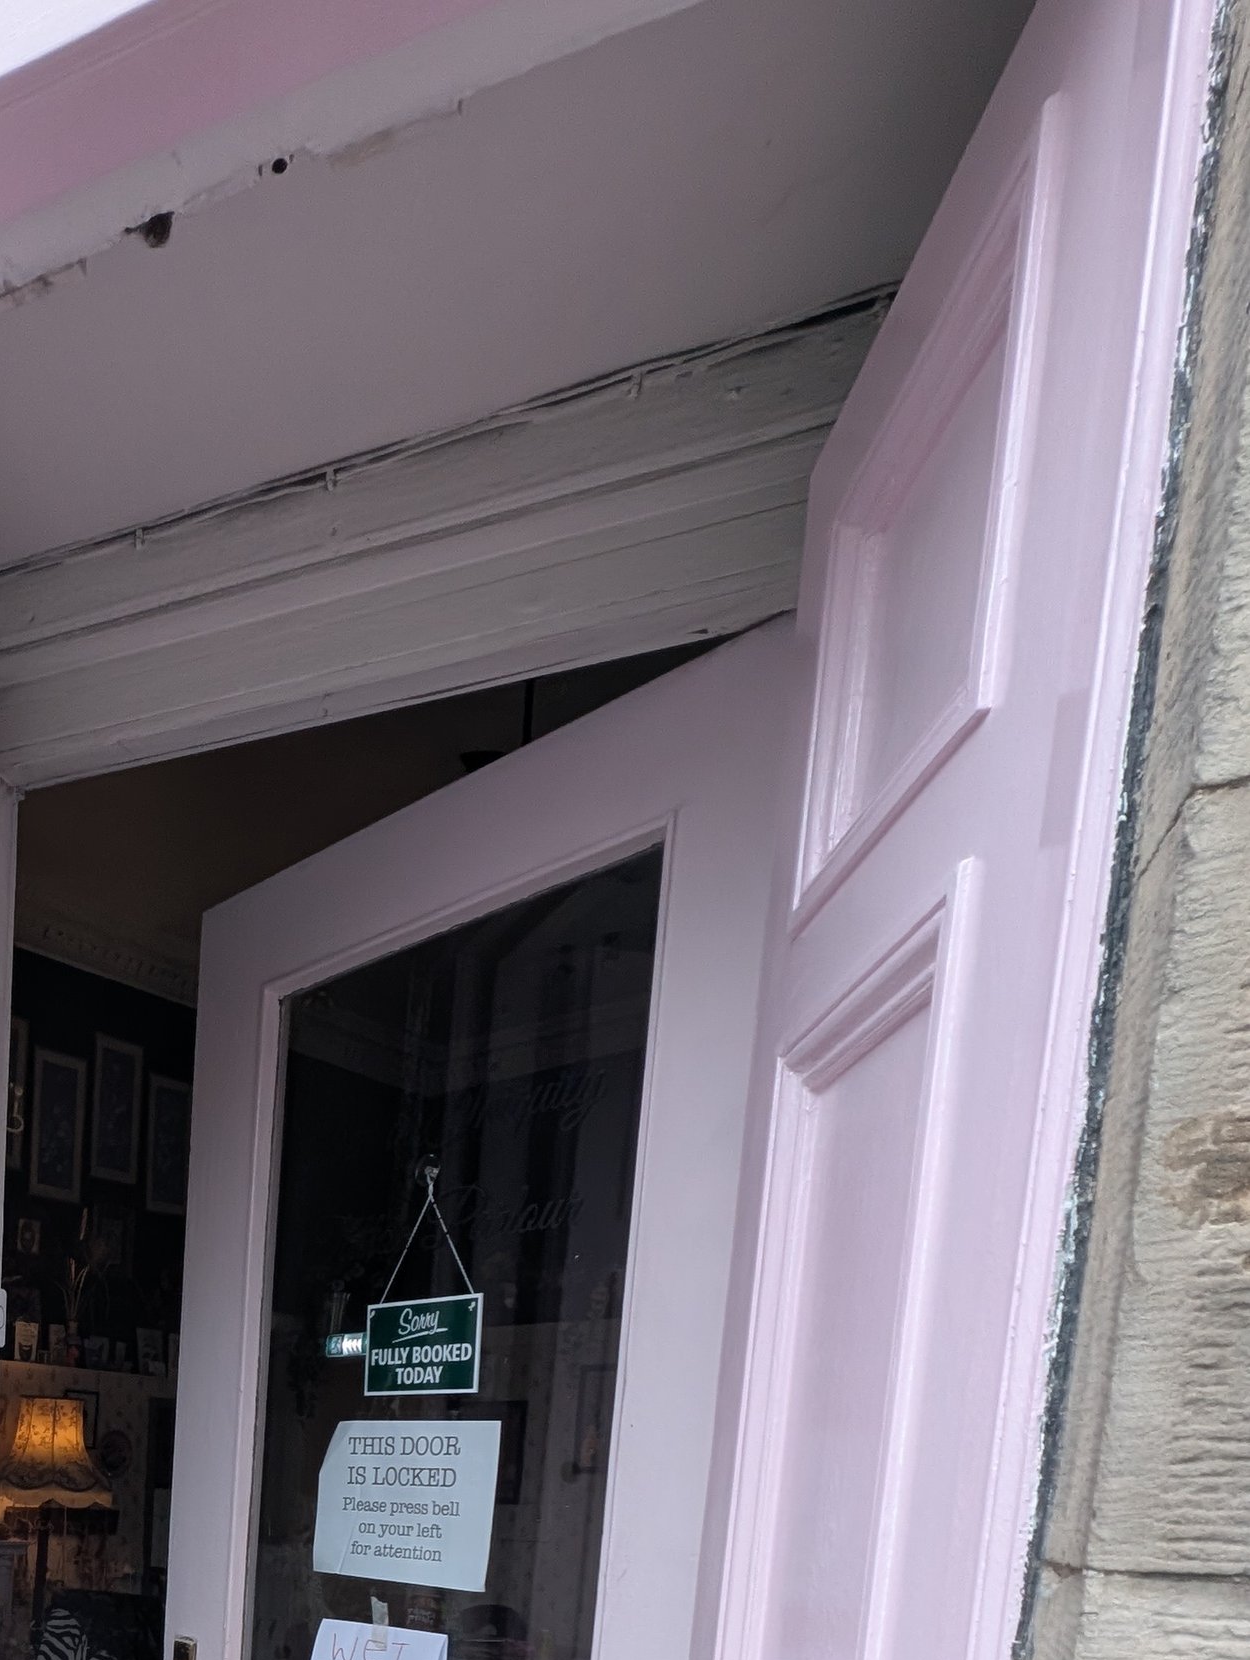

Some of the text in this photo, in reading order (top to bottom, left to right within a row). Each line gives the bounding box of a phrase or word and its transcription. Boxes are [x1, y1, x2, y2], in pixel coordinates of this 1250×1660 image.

[398, 1308, 440, 1335] Sorry
[371, 1343, 472, 1366] FULLY BOOKED
[395, 1366, 443, 1385] TODAY
[348, 1436, 461, 1456] THIS DOOR
[347, 1466, 457, 1488] IS LOCKED
[342, 1497, 460, 1517] Please press bell
[358, 1522, 442, 1539] on your left
[350, 1541, 442, 1562] for attention
